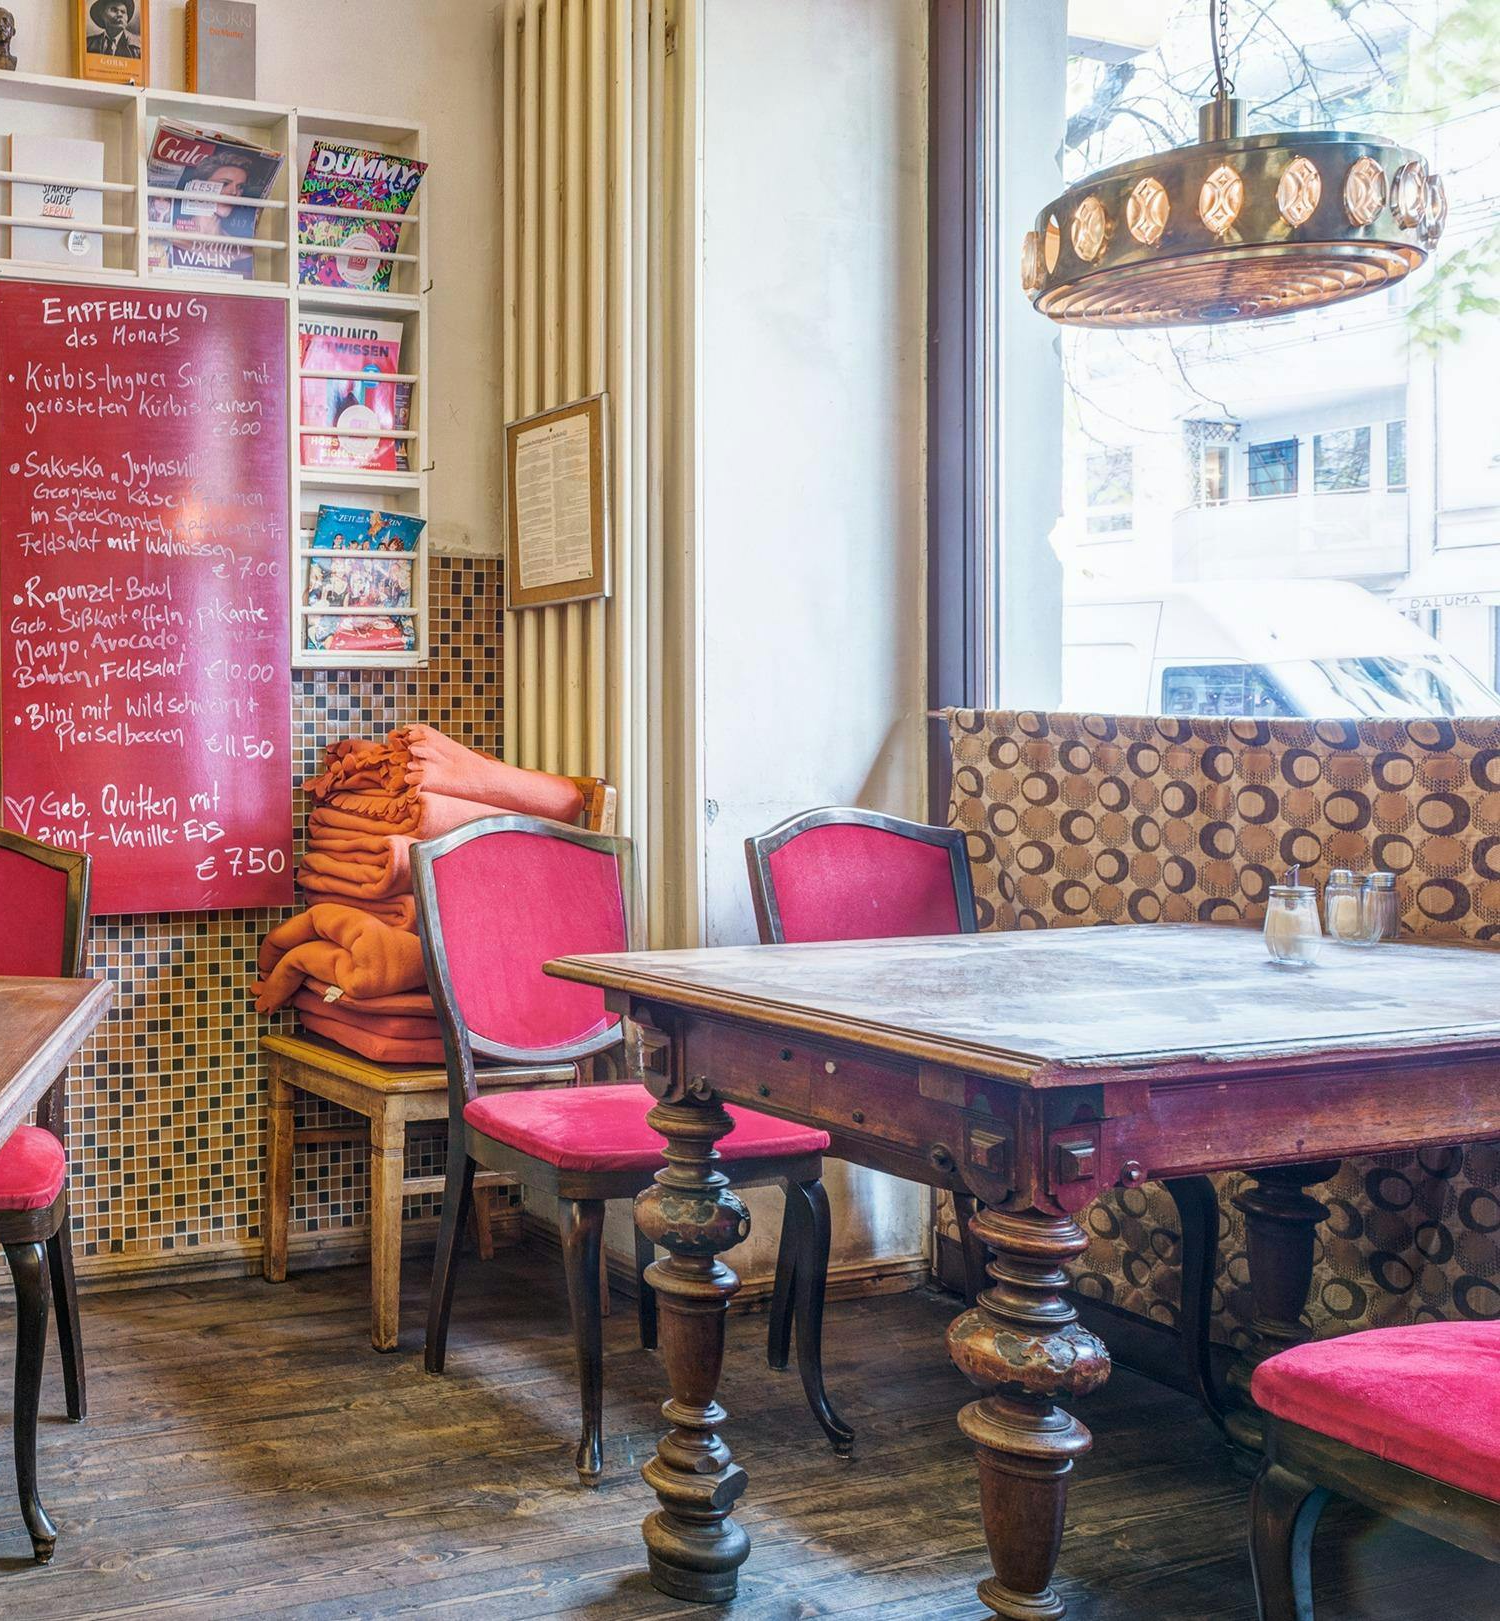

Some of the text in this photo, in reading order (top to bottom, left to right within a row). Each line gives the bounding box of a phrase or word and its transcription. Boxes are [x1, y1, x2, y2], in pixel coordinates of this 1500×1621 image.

[314, 150, 416, 184] DUMMY
[43, 194, 72, 206] GUIDE
[191, 181, 220, 193] LESE
[42, 205, 74, 217] BERLIN
[42, 297, 208, 325] EMPFEHLUNG
[65, 323, 181, 348] des Monats
[334, 343, 389, 357] WISSEN
[25, 393, 128, 435] gerösteten
[33, 482, 117, 510] Georgischer
[30, 506, 50, 526] im
[338, 514, 357, 523] ZEIT
[16, 527, 235, 564] Feldsalat mit Walnüssen
[1410, 595, 1482, 609] DALUMA
[11, 615, 53, 636] Geb.
[196, 597, 269, 632] pikante
[25, 702, 75, 731] Blini
[81, 693, 113, 722] mit
[54, 720, 185, 753] Preiselbeeren
[39, 780, 221, 822] Geb. Quitten mit
